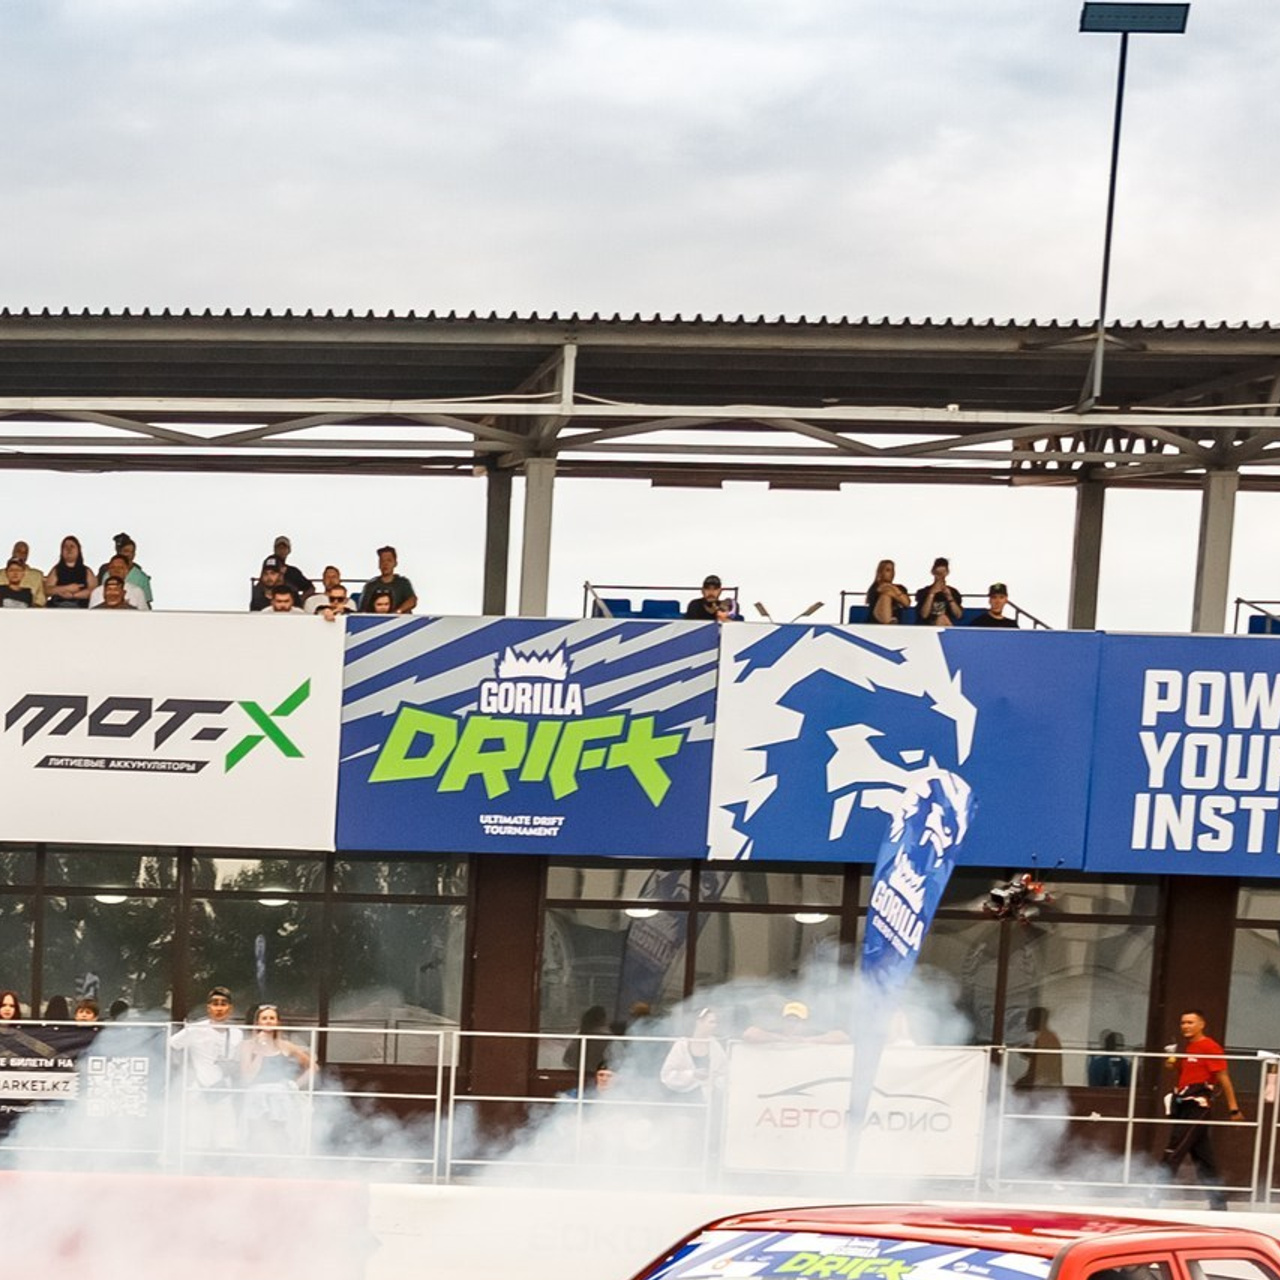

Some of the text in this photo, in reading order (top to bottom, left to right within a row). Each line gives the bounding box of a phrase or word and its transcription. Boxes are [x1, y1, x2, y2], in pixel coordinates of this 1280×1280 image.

[480, 681, 584, 715] GORILLA
[1141, 669, 1280, 730] POW
[109, 760, 196, 771] АККУМУЛЯТОРЫ
[480, 814, 565, 826] ULTIMATE DRIFT
[483, 825, 560, 836] TOURNAMENT
[1131, 793, 1280, 853] INST
[871, 880, 924, 951] GORILLA
[9, 1057, 54, 1068] БИЛЕТЫ
[57, 1059, 74, 1068] НА
